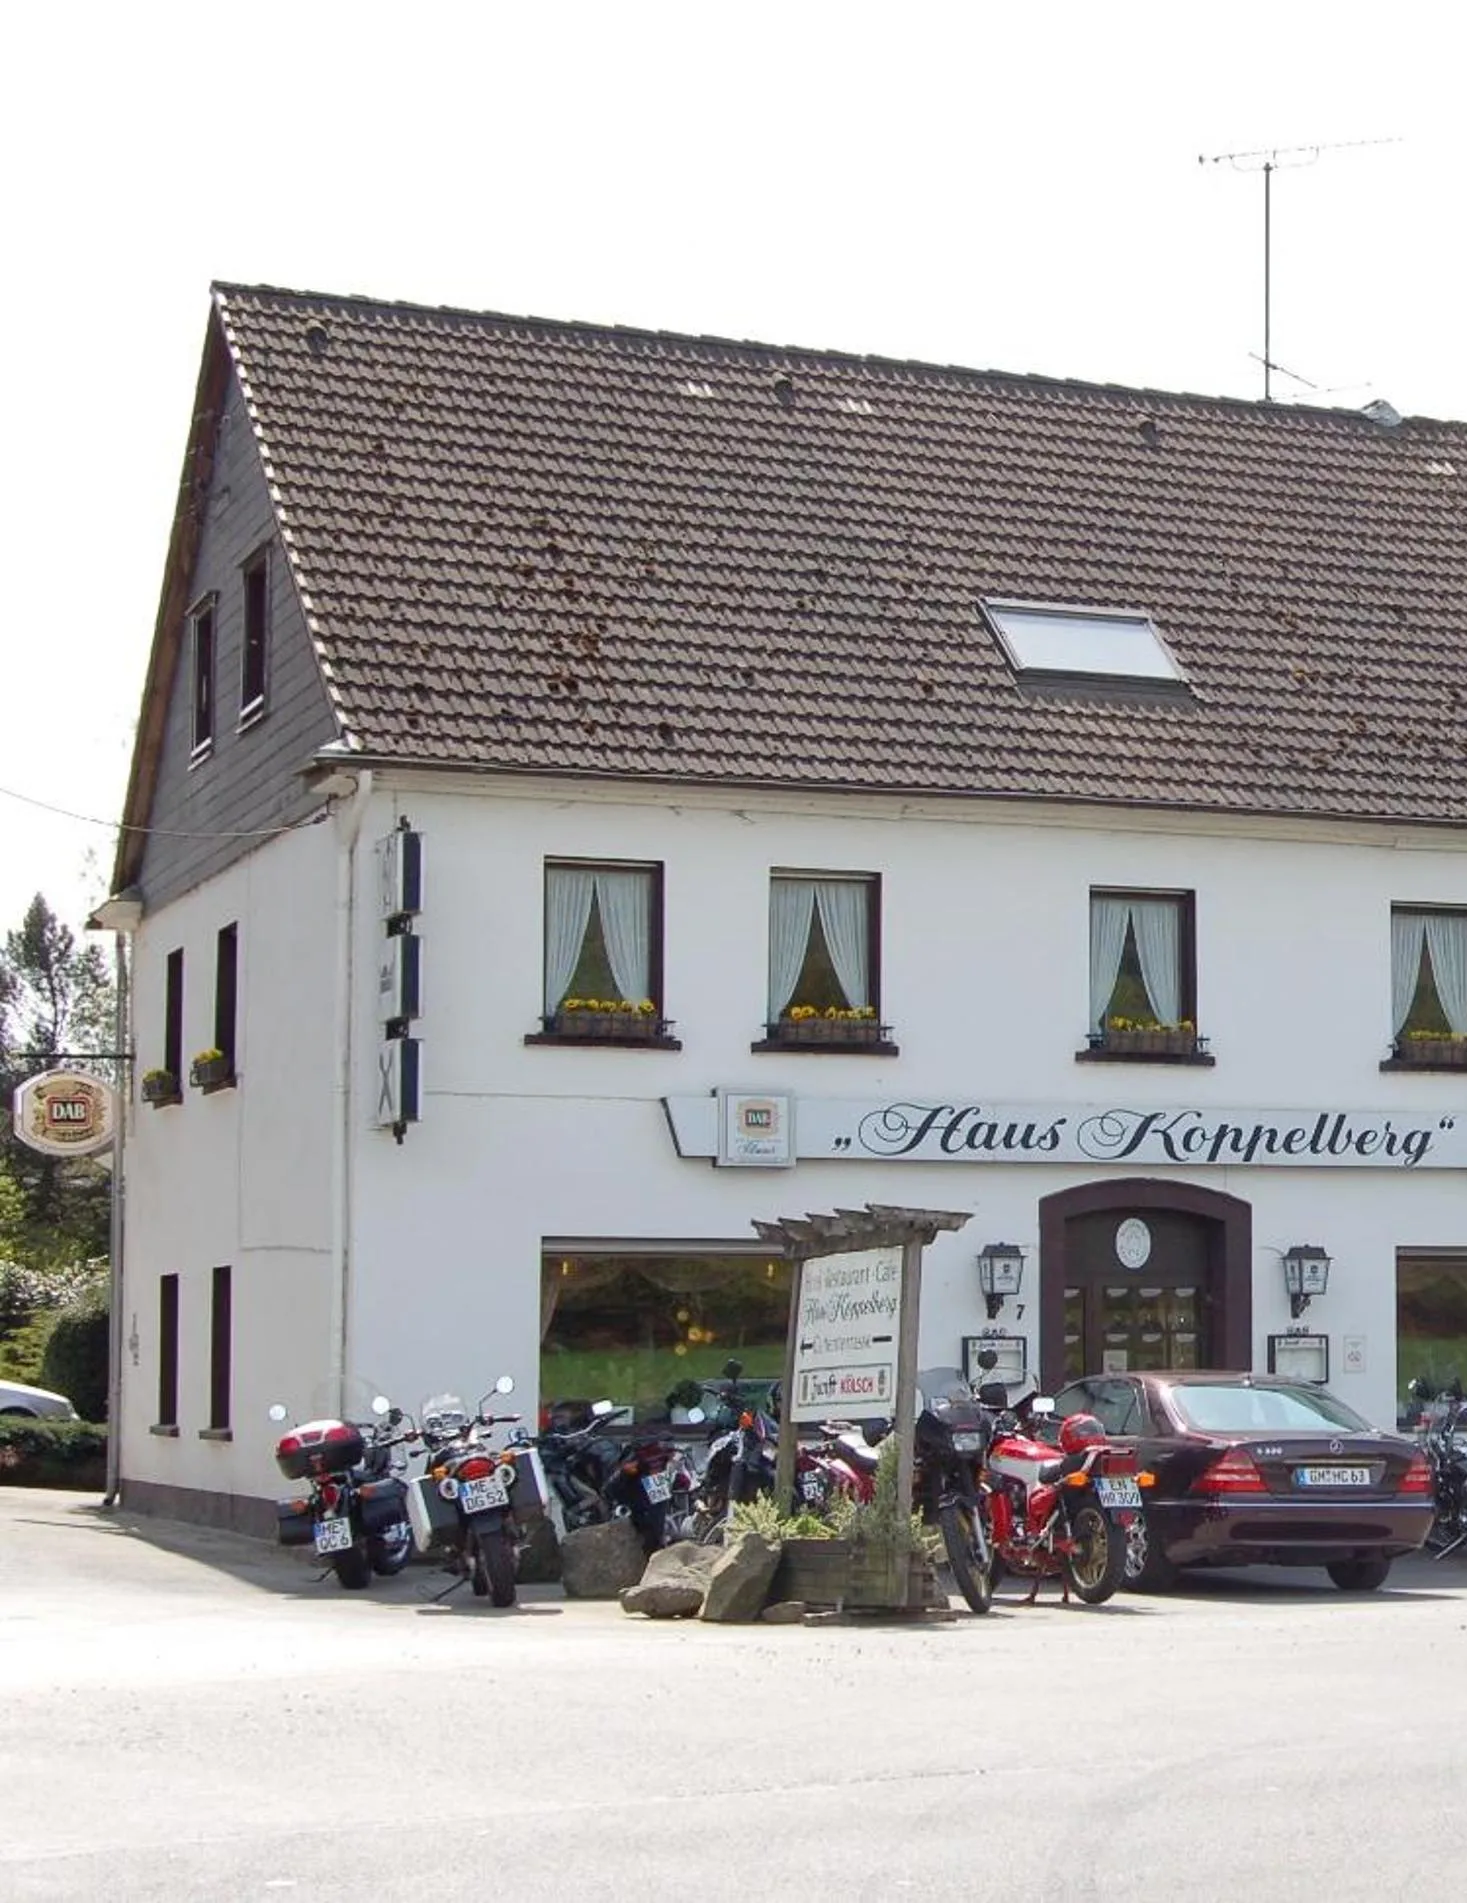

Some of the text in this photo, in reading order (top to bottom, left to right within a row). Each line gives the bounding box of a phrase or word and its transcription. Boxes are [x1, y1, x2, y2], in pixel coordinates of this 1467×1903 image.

[52, 1102, 86, 1120] DAB
[1016, 1304, 1026, 1320] 7
[1310, 1470, 1325, 1482] GM
